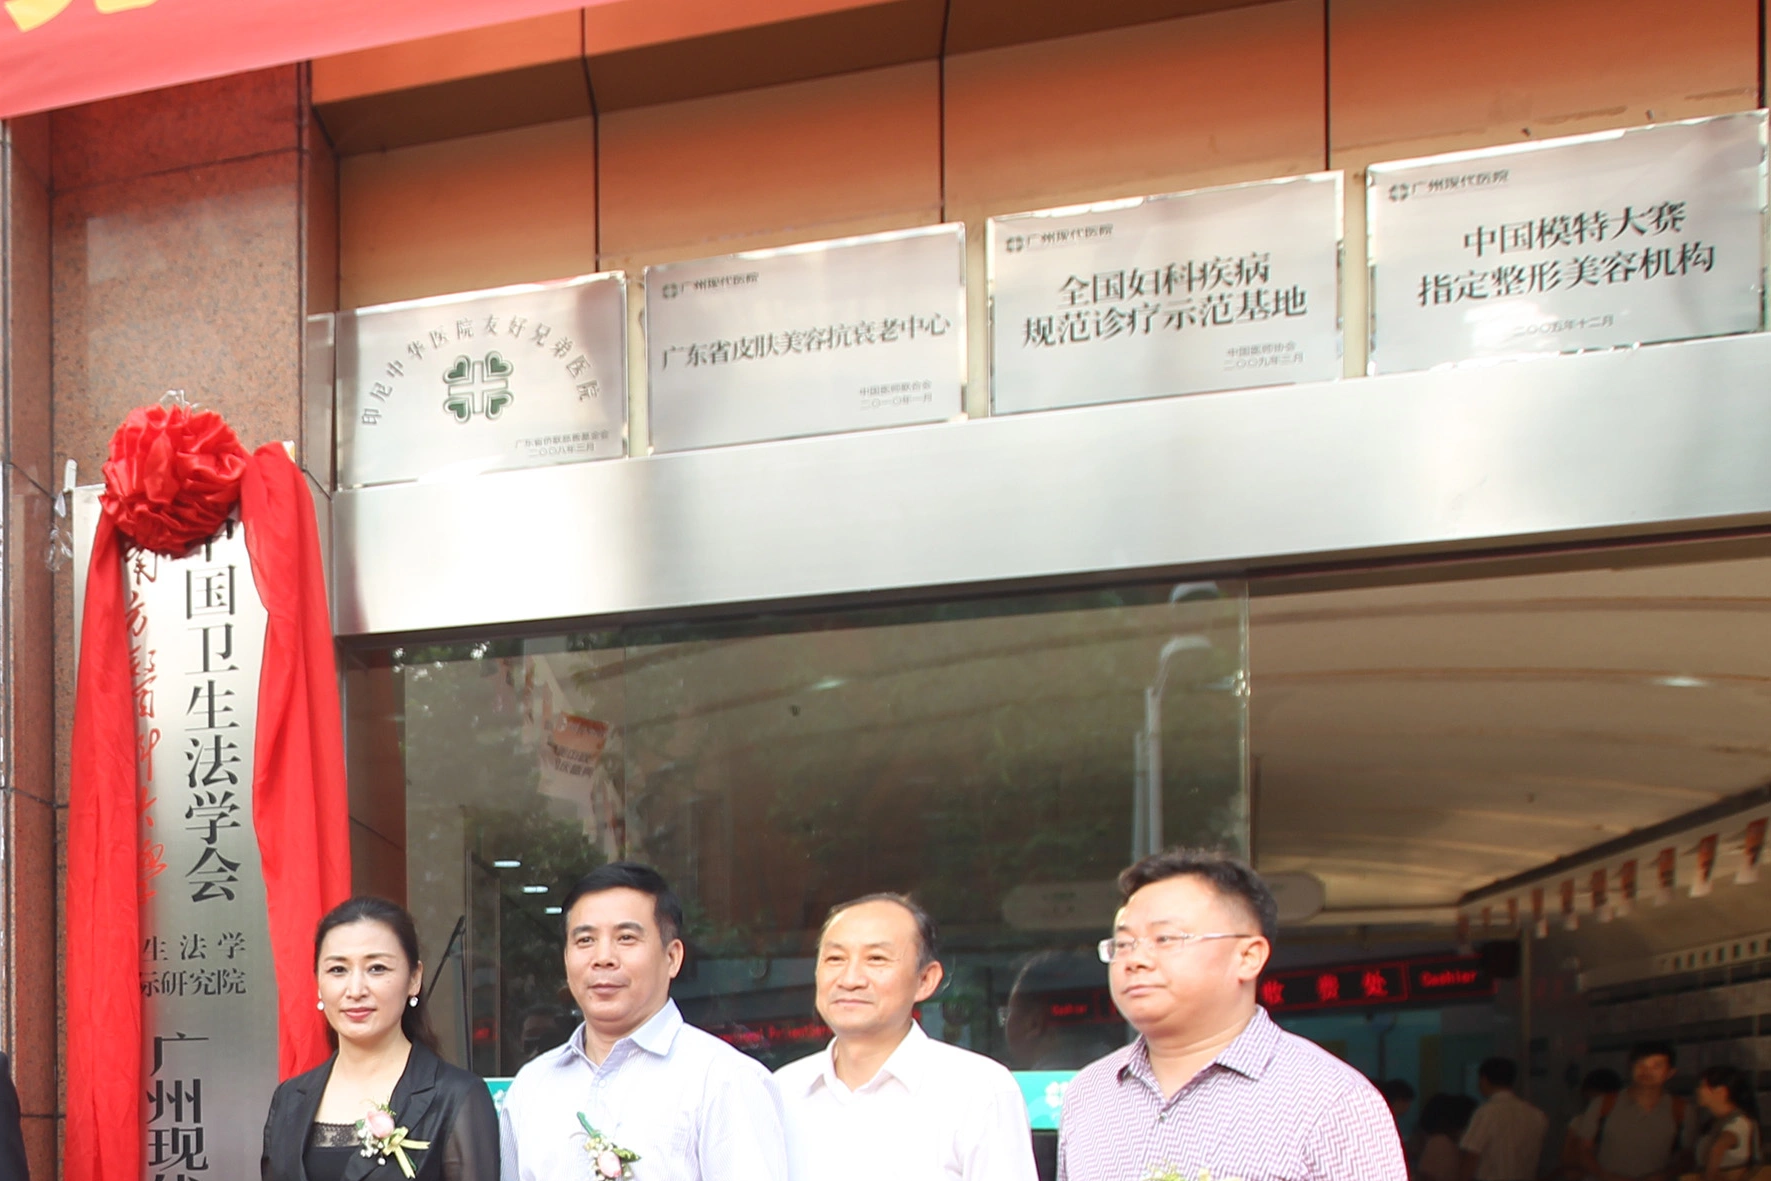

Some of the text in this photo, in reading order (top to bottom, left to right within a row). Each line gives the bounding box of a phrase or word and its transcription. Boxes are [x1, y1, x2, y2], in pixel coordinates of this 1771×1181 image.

[1463, 200, 1688, 258] 中国模特大赛
[1056, 251, 1272, 307] 全国妇科疾病
[1417, 241, 1716, 307] 指定整形美容机构
[661, 311, 952, 370] 广东省皮肤美容抗衰老中心
[1022, 284, 1308, 348] 规范诊疗示范基地
[184, 518, 242, 903] 国卫生法学会
